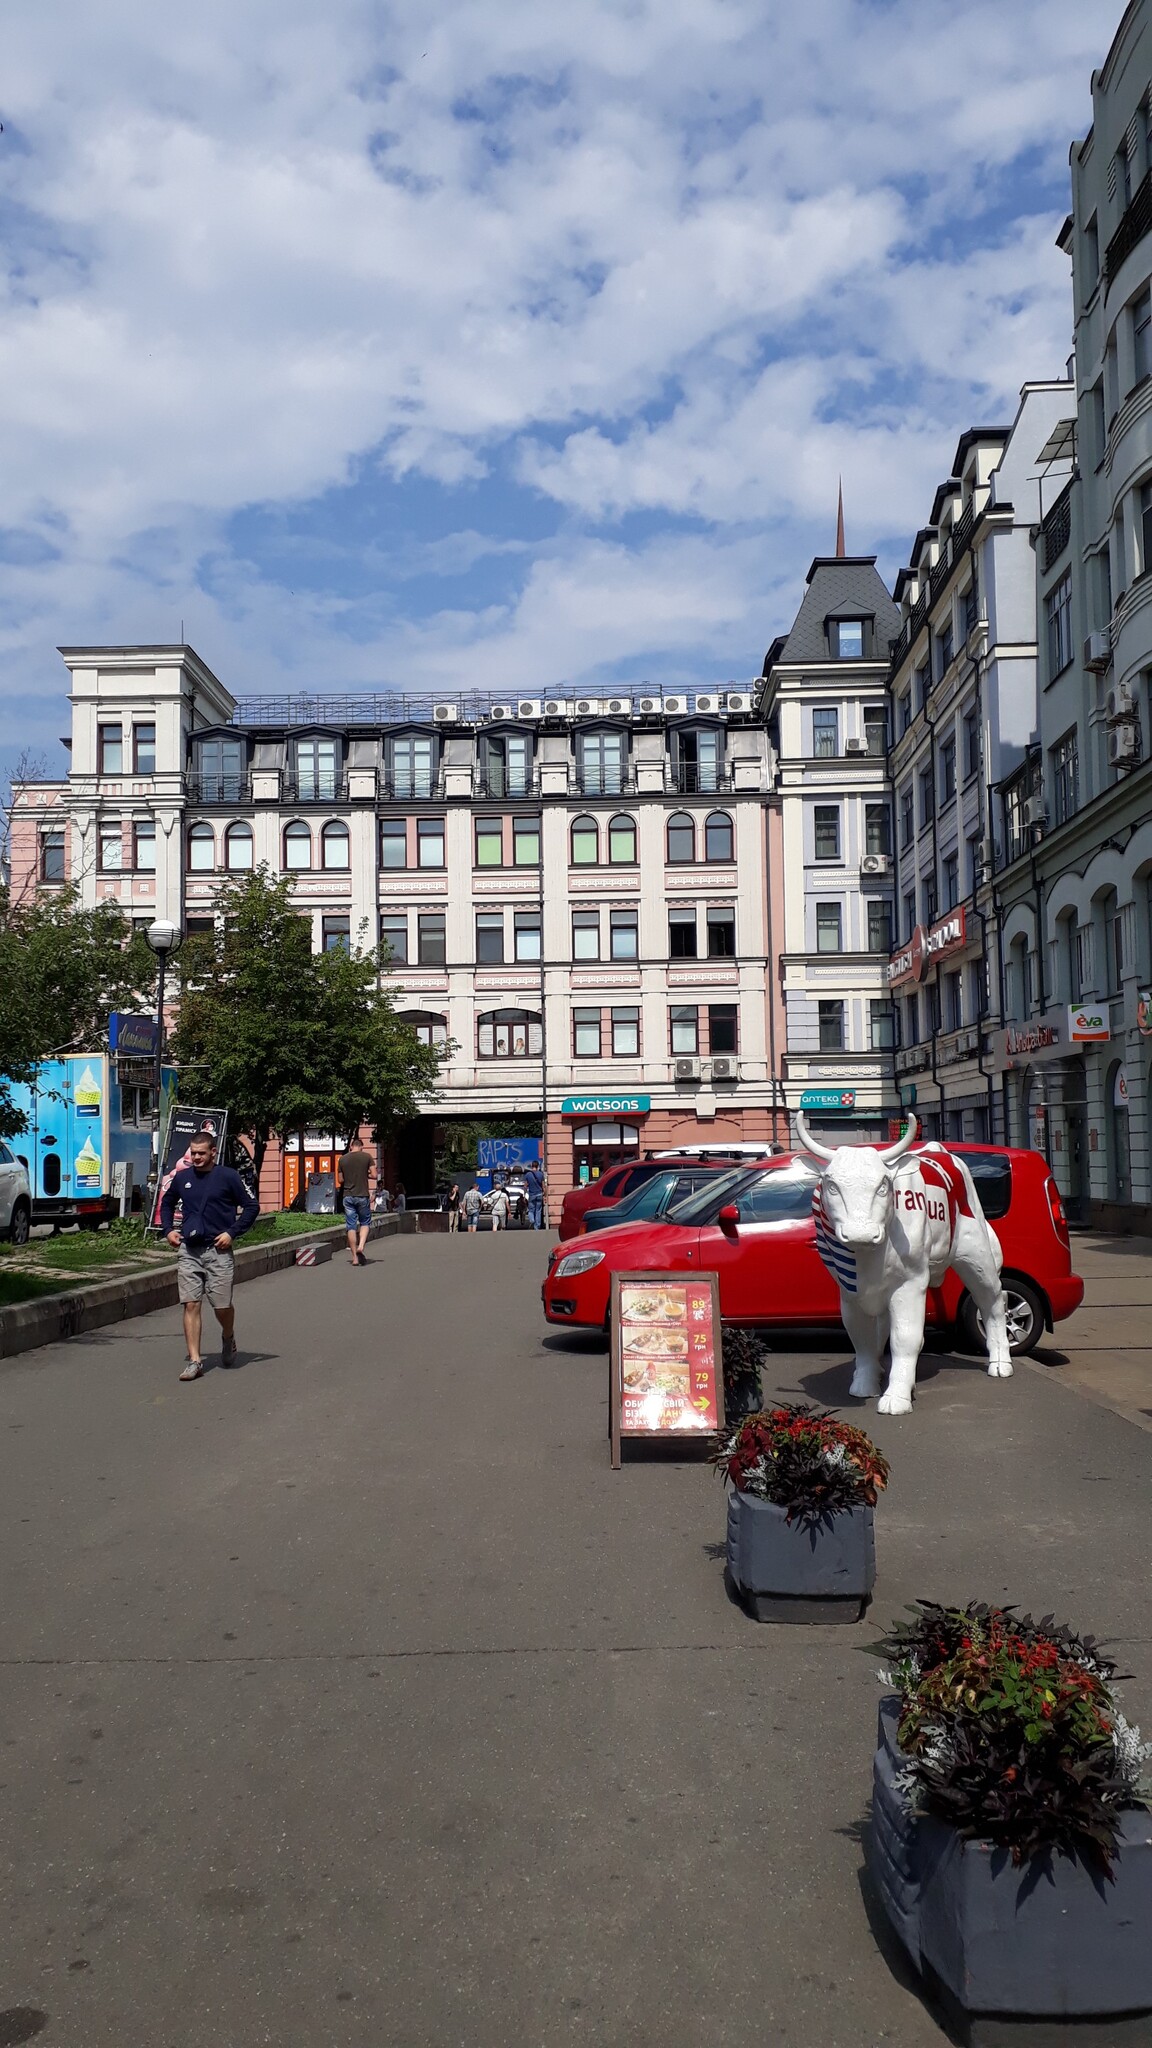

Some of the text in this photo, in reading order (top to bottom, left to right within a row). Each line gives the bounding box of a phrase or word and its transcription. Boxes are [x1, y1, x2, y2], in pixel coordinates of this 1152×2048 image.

[572, 1100, 639, 1110] watsons
[692, 1300, 706, 1309] 89
[693, 1334, 707, 1343] 75
[695, 1372, 709, 1382] 79
